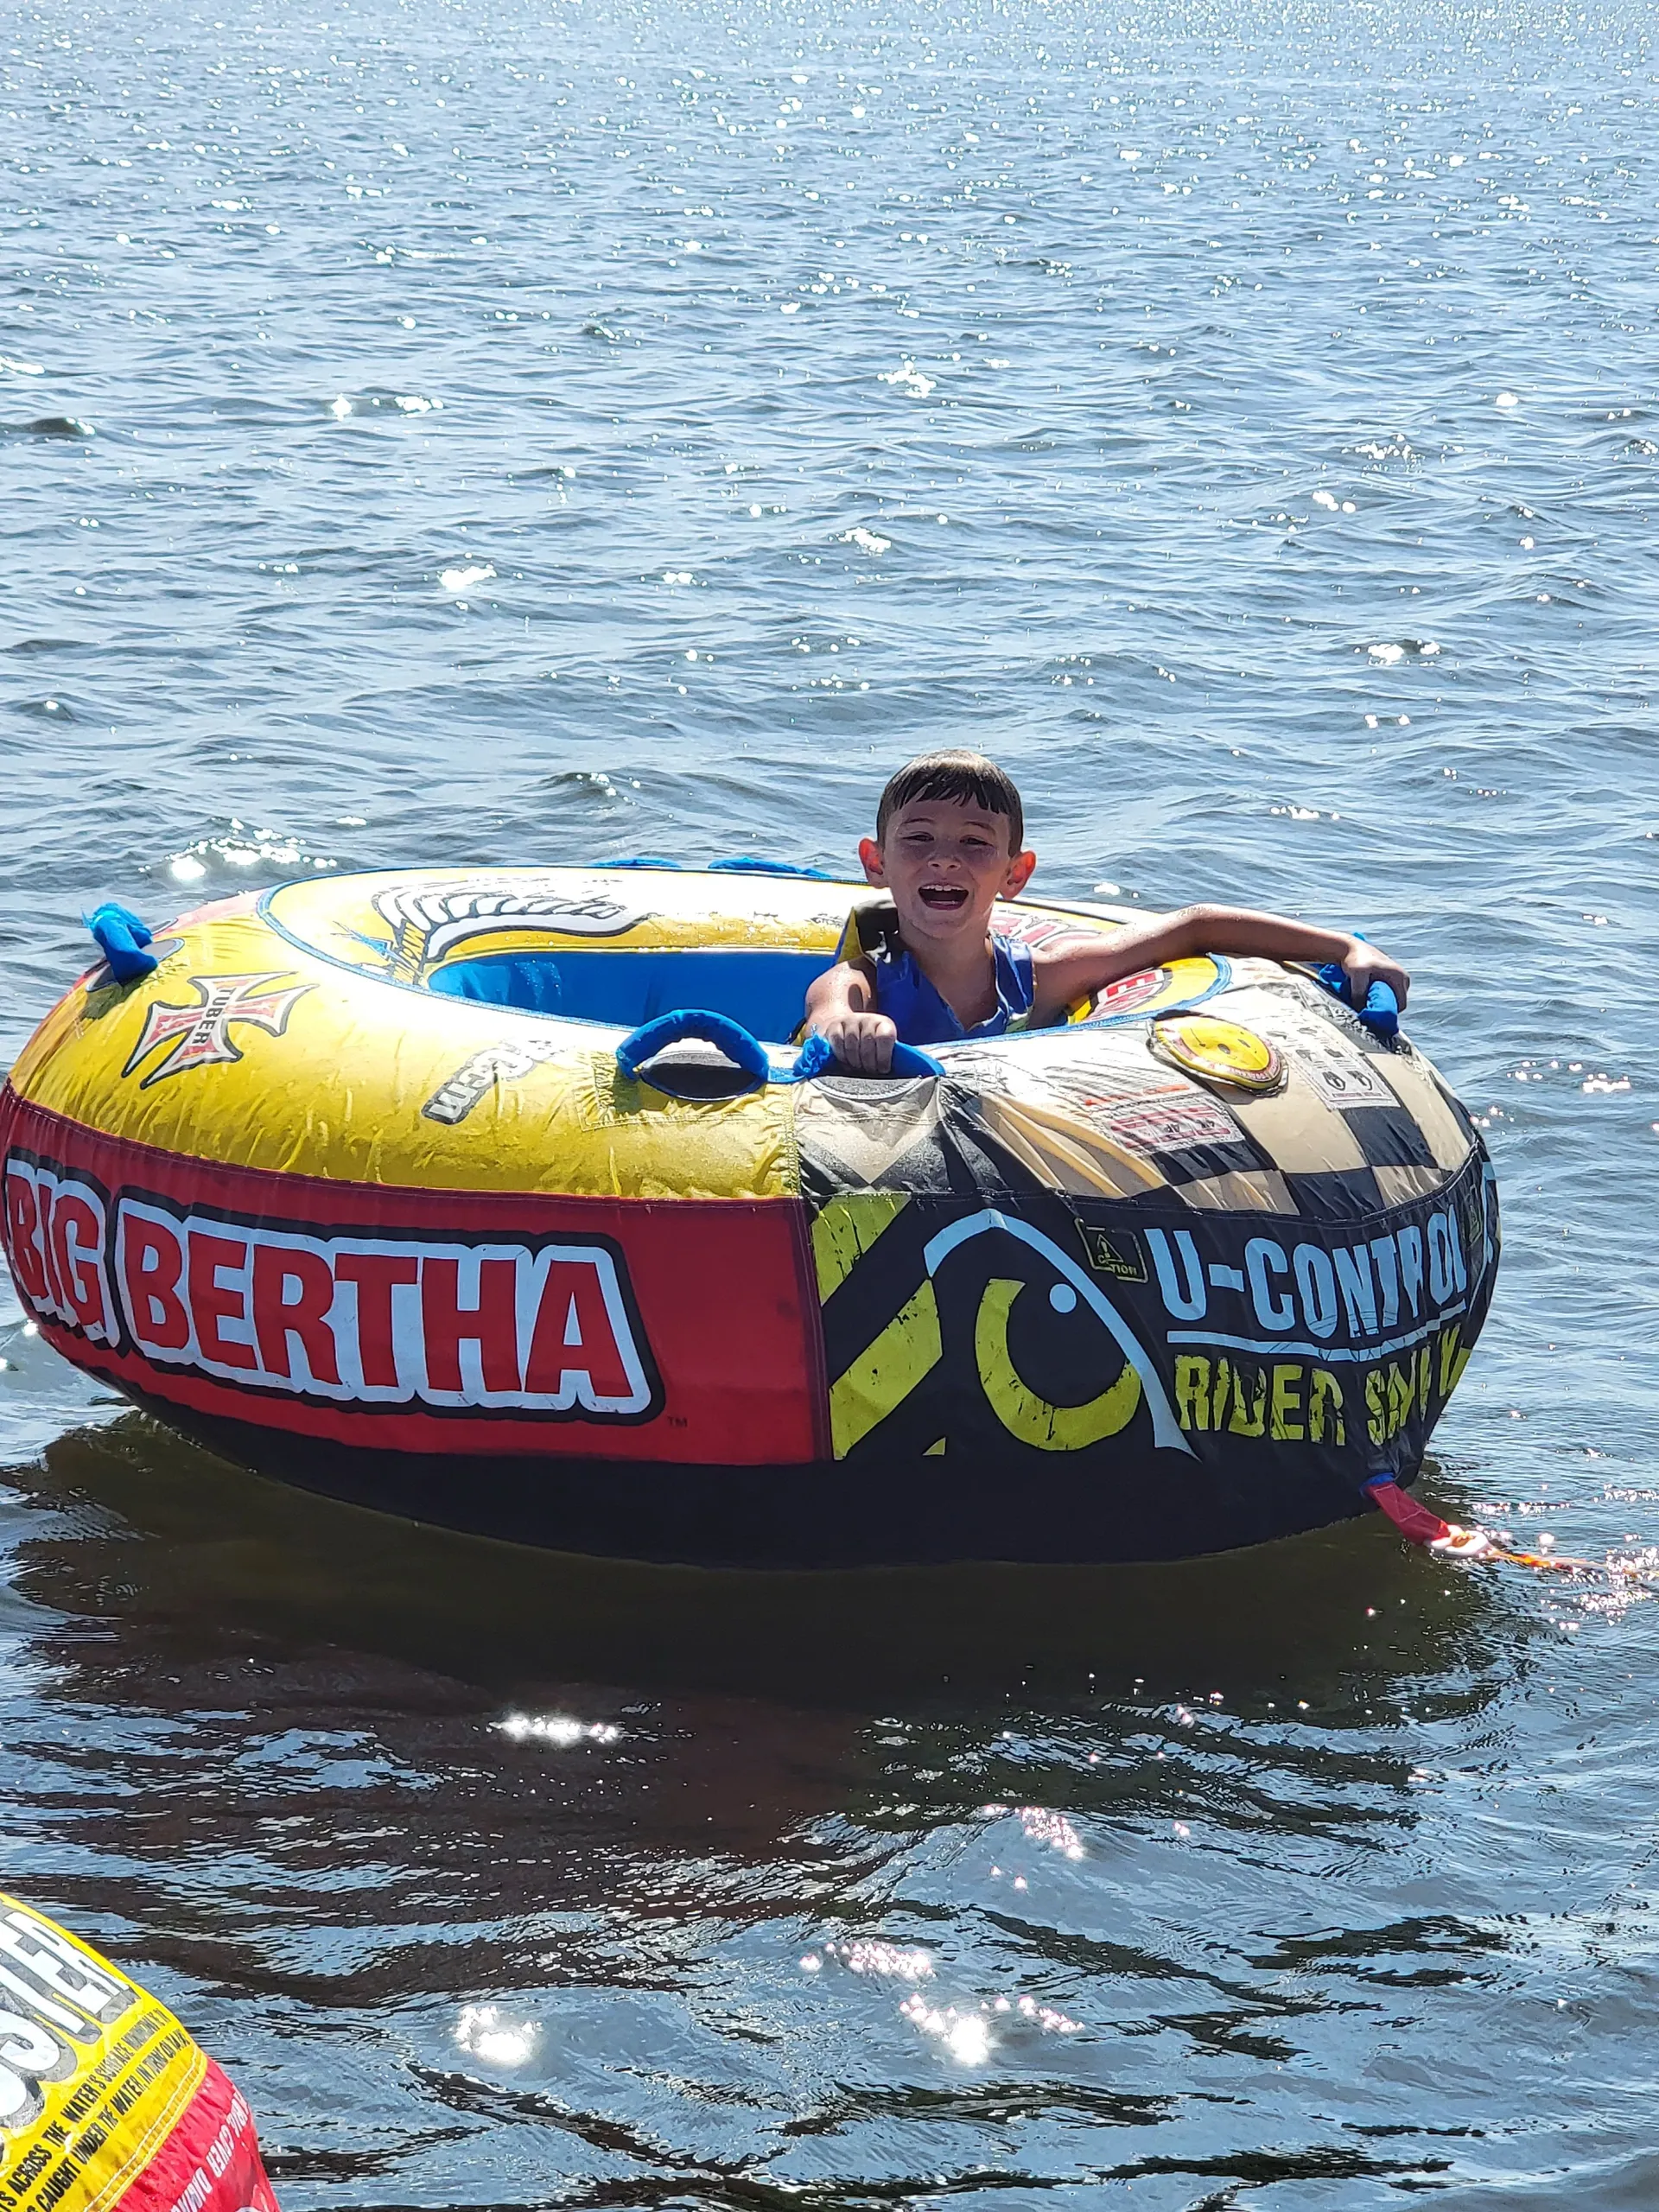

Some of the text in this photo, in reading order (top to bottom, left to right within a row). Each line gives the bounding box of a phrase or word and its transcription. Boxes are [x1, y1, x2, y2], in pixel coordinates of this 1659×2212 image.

[192, 987, 238, 1045] TUBER
[4, 1156, 653, 1415] BIG BERTHA
[1096, 1253, 1138, 1277] CTION
[1174, 1353, 1347, 1447] RIDER
[6, 2144, 52, 2196] ACROSS
[41, 2120, 71, 2148] THE
[60, 2074, 107, 2124] WATER'S
[35, 2157, 81, 2212] CAUGHT
[71, 2121, 109, 2165] UNDER
